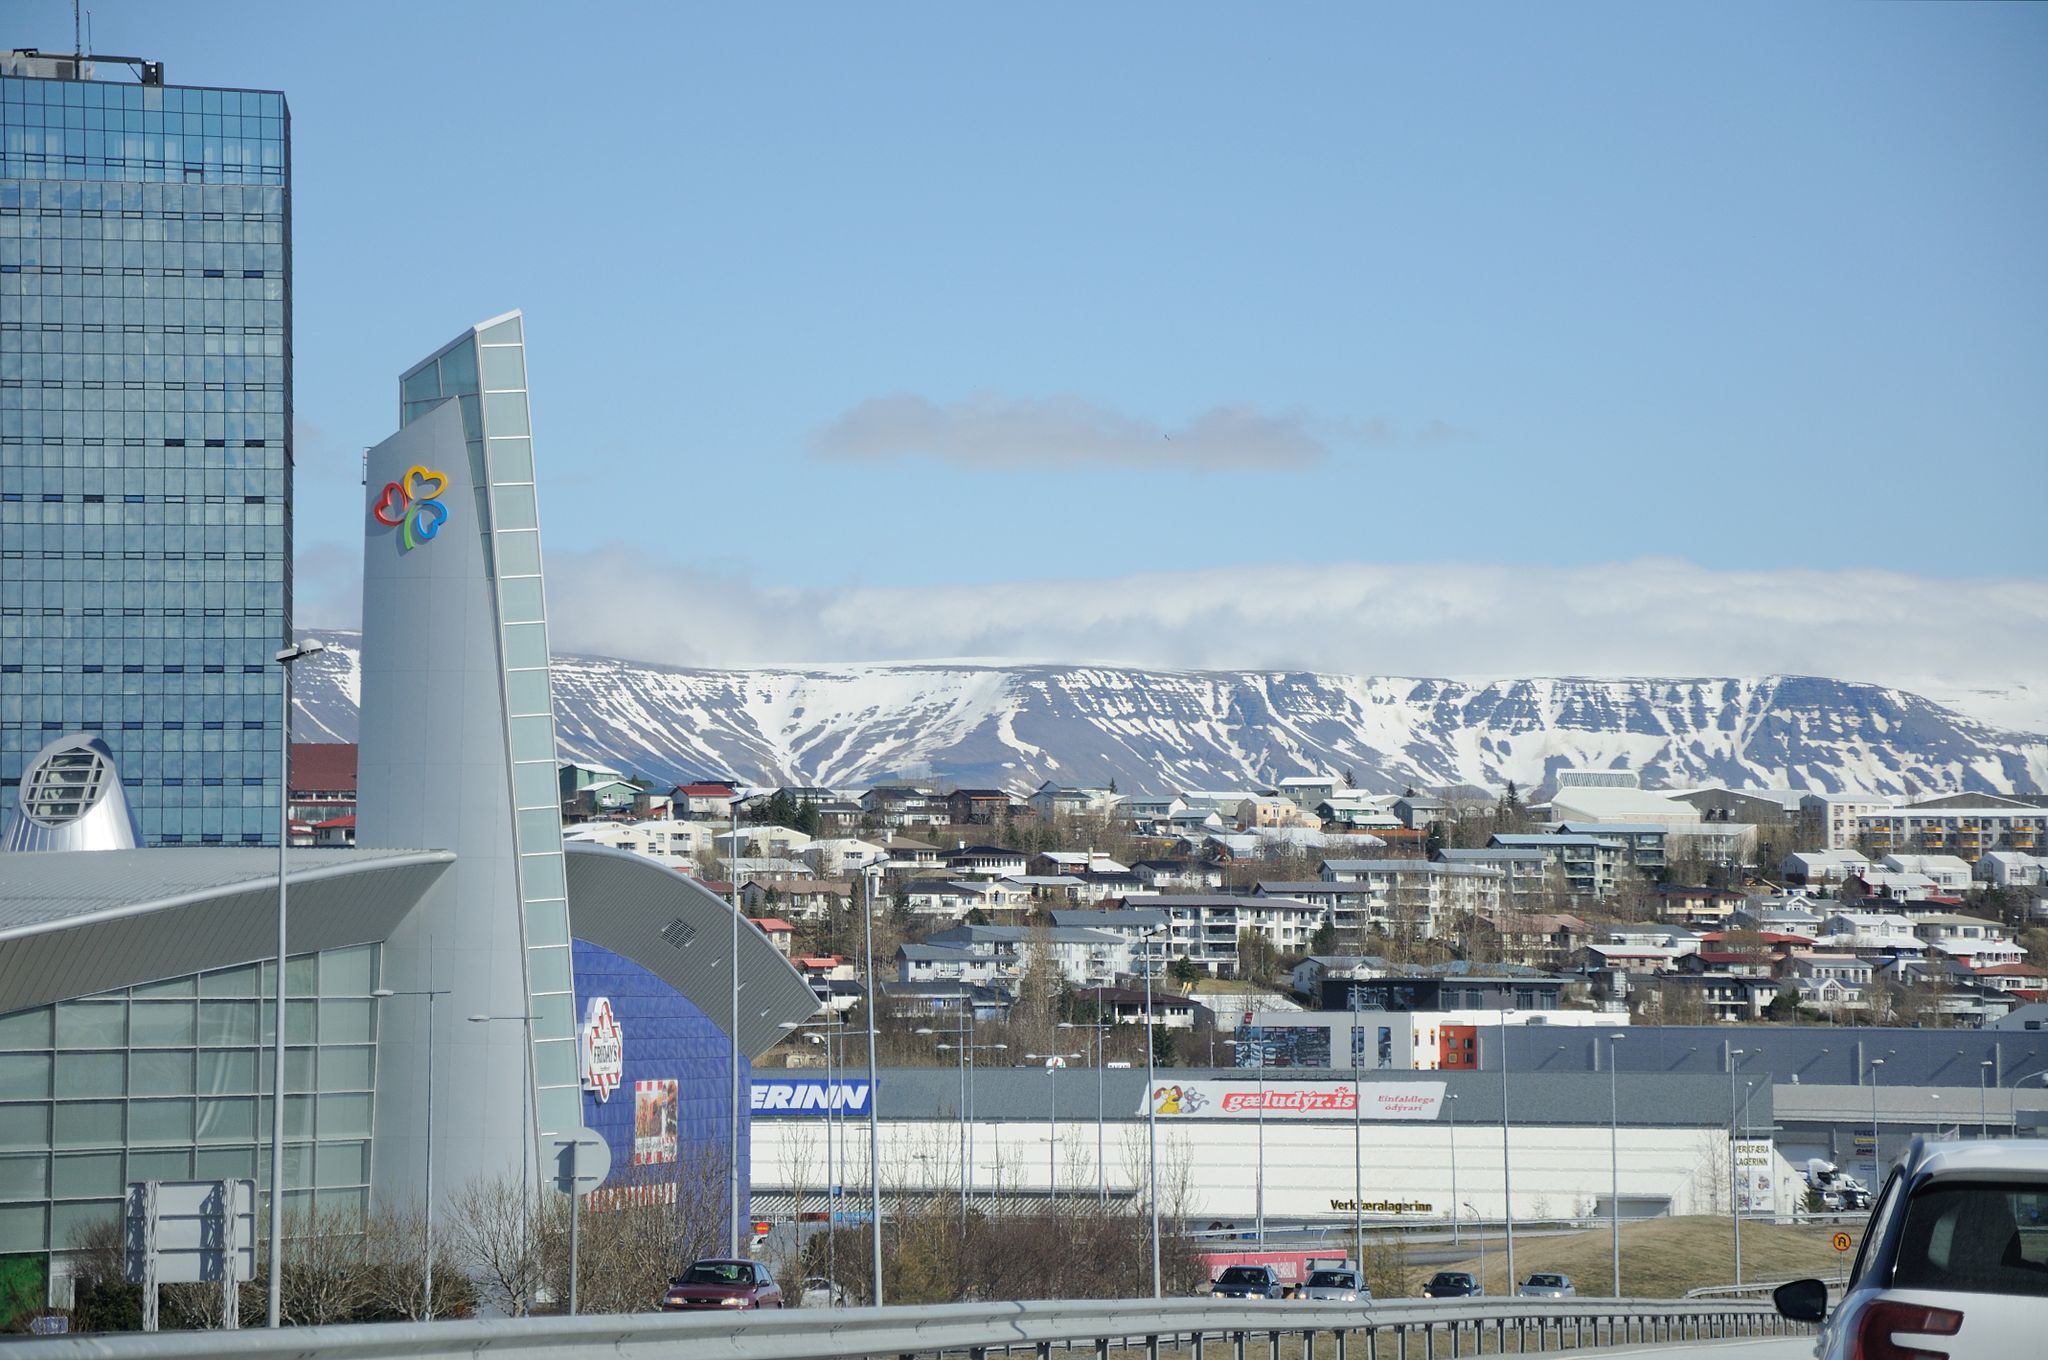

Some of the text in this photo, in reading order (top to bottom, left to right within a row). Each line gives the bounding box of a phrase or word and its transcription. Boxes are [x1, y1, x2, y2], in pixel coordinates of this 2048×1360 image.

[751, 1085, 869, 1109] ERINN
[1225, 1090, 1355, 1113] gæludýr.is
[1377, 1095, 1435, 1105] Einfaldlega
[1330, 1199, 1433, 1215] Verkæralagerinn
